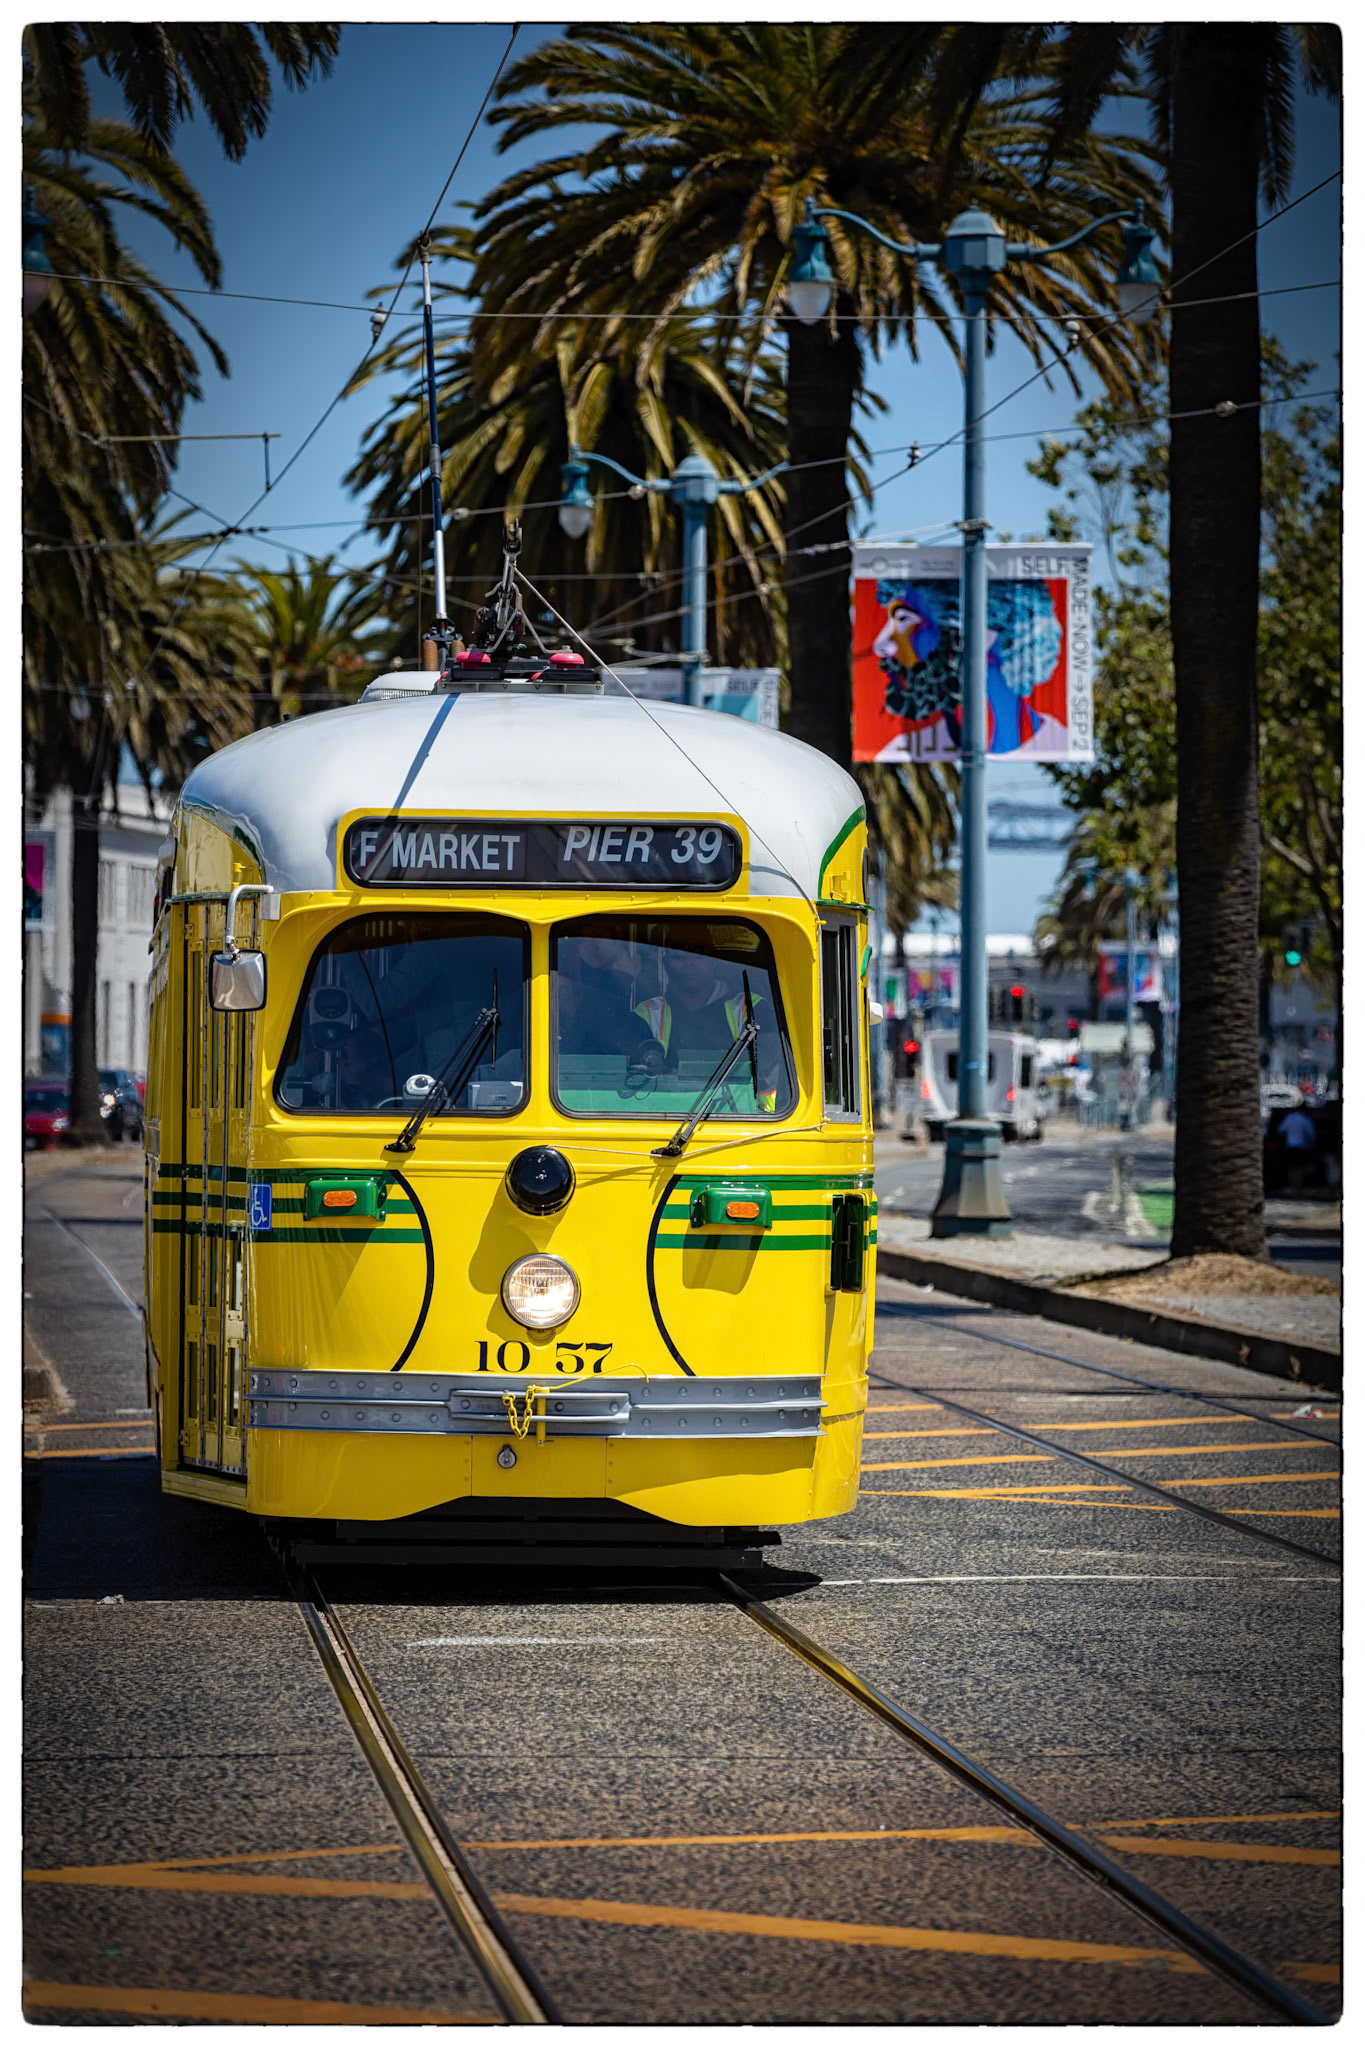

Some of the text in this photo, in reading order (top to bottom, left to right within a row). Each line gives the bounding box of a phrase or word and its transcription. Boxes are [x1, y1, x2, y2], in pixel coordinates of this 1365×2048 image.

[1070, 556, 1090, 752] MADE NOW SEP 2
[359, 825, 724, 871] F MARKET PIER 39
